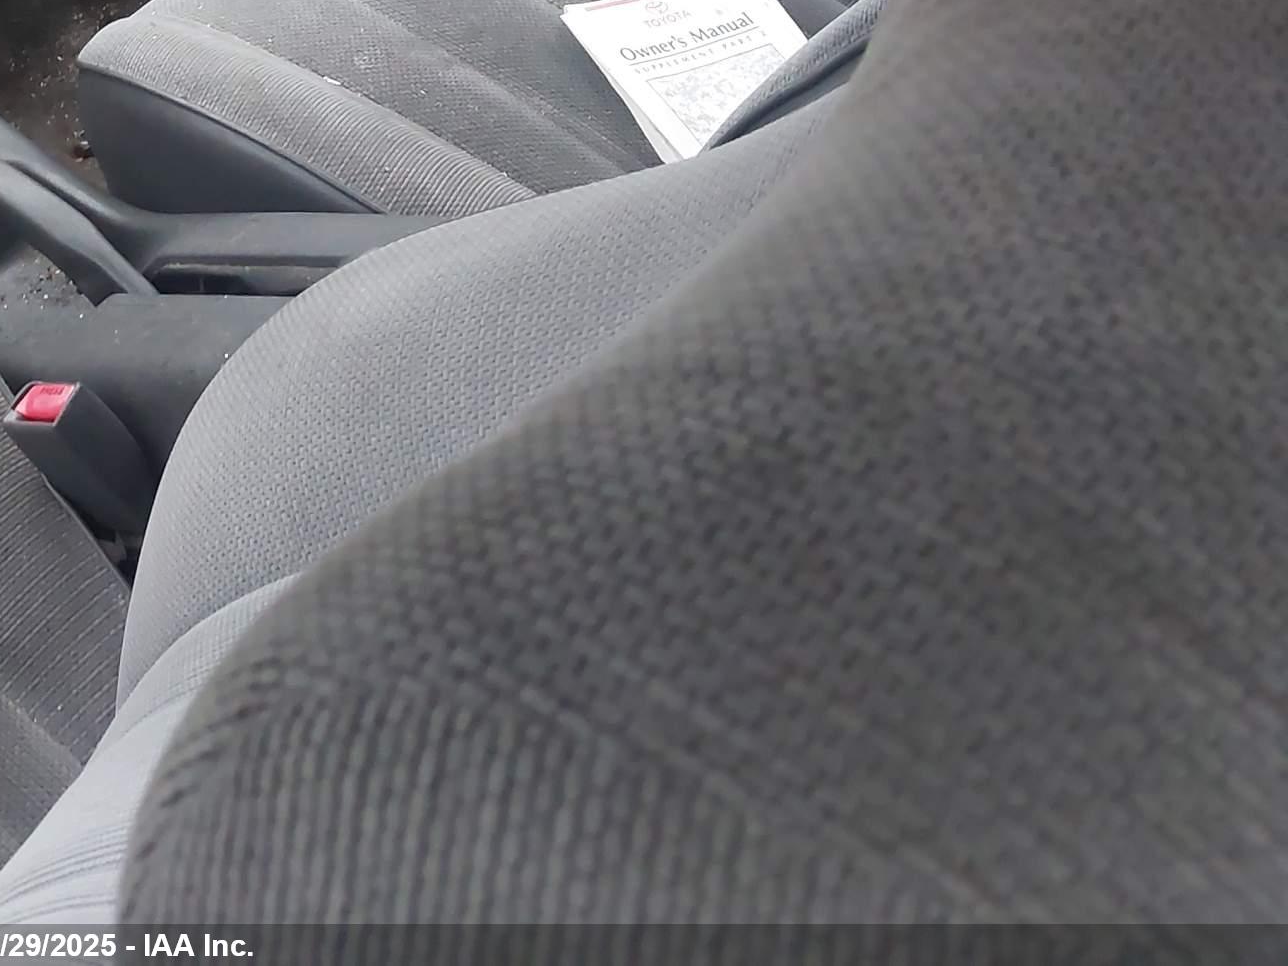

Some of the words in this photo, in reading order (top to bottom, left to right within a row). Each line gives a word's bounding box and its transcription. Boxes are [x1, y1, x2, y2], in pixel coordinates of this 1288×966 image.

[619, 34, 689, 62] Owner's
[688, 10, 755, 44] Manual
[643, 9, 692, 29] TOYOTA
